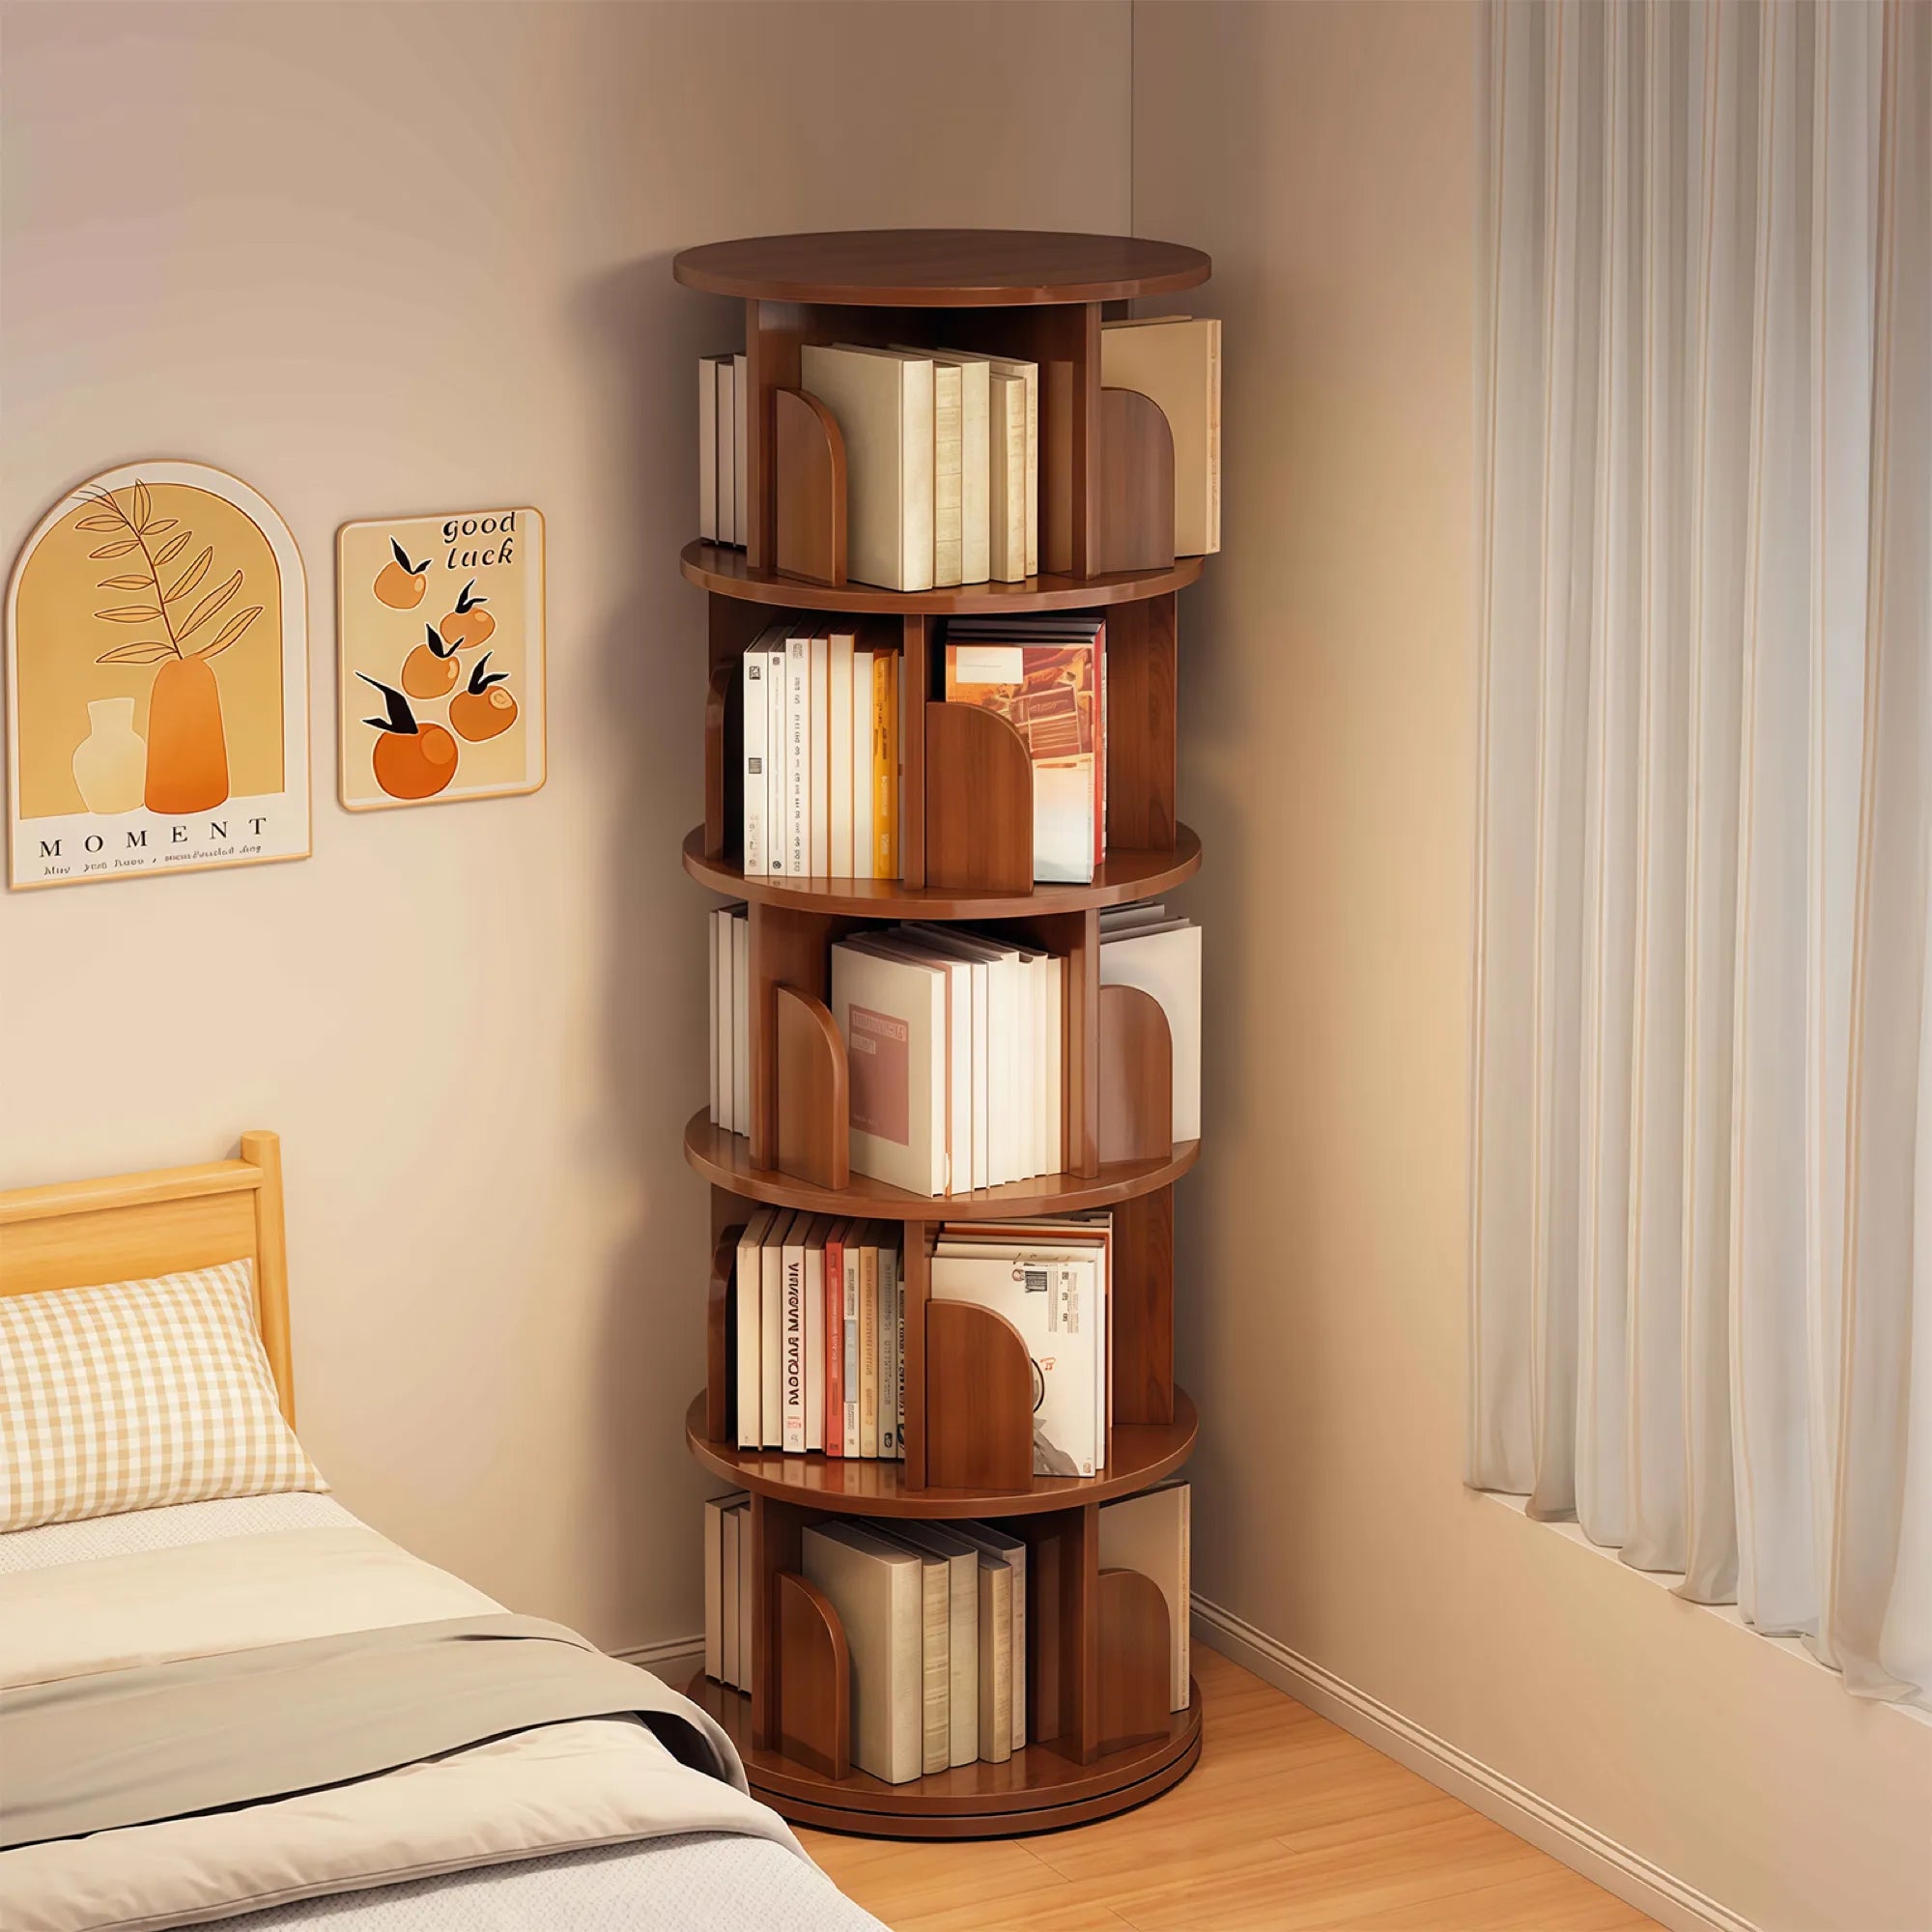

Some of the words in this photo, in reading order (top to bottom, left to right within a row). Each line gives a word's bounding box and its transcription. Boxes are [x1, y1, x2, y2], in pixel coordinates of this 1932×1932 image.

[443, 512, 515, 544] good
[447, 537, 513, 569] luck
[40, 817, 268, 858] MOMENT
